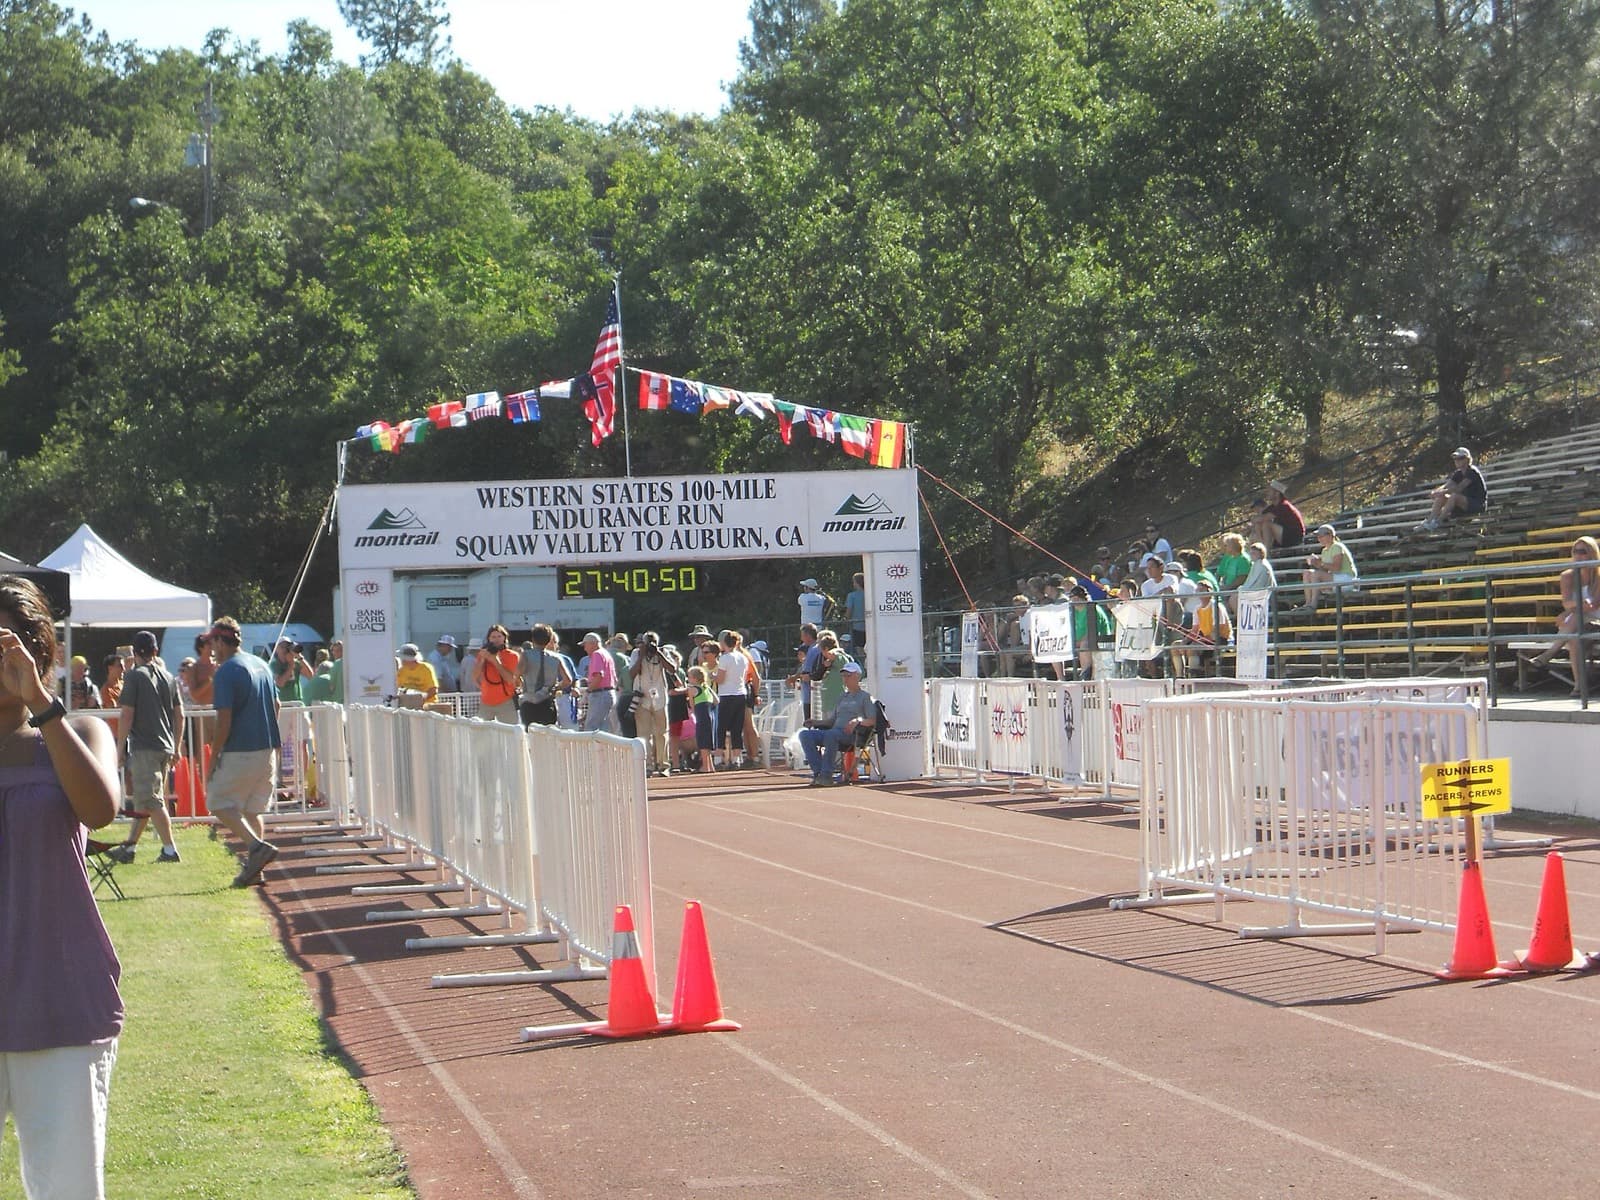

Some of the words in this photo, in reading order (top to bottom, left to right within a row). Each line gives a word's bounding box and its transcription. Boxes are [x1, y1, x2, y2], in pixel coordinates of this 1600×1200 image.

[476, 484, 583, 509] WESTERN
[592, 480, 673, 505] STATES
[681, 478, 776, 502] 100-MILE
[532, 505, 671, 531] ENDURANCE
[677, 503, 724, 526] RUN
[822, 516, 905, 533] montrail
[354, 531, 440, 548] montrail
[456, 534, 539, 562] SQUAW
[544, 531, 625, 556] VALLEY
[631, 530, 664, 551] TO
[670, 526, 769, 551] AUBURN,
[775, 525, 804, 547] CA
[885, 590, 912, 598] BANK
[879, 604, 900, 612] USA
[350, 623, 371, 631] USA
[1437, 764, 1494, 777] RUNNERS
[1424, 791, 1465, 801] PACERS,
[1468, 788, 1502, 798] CREWS
